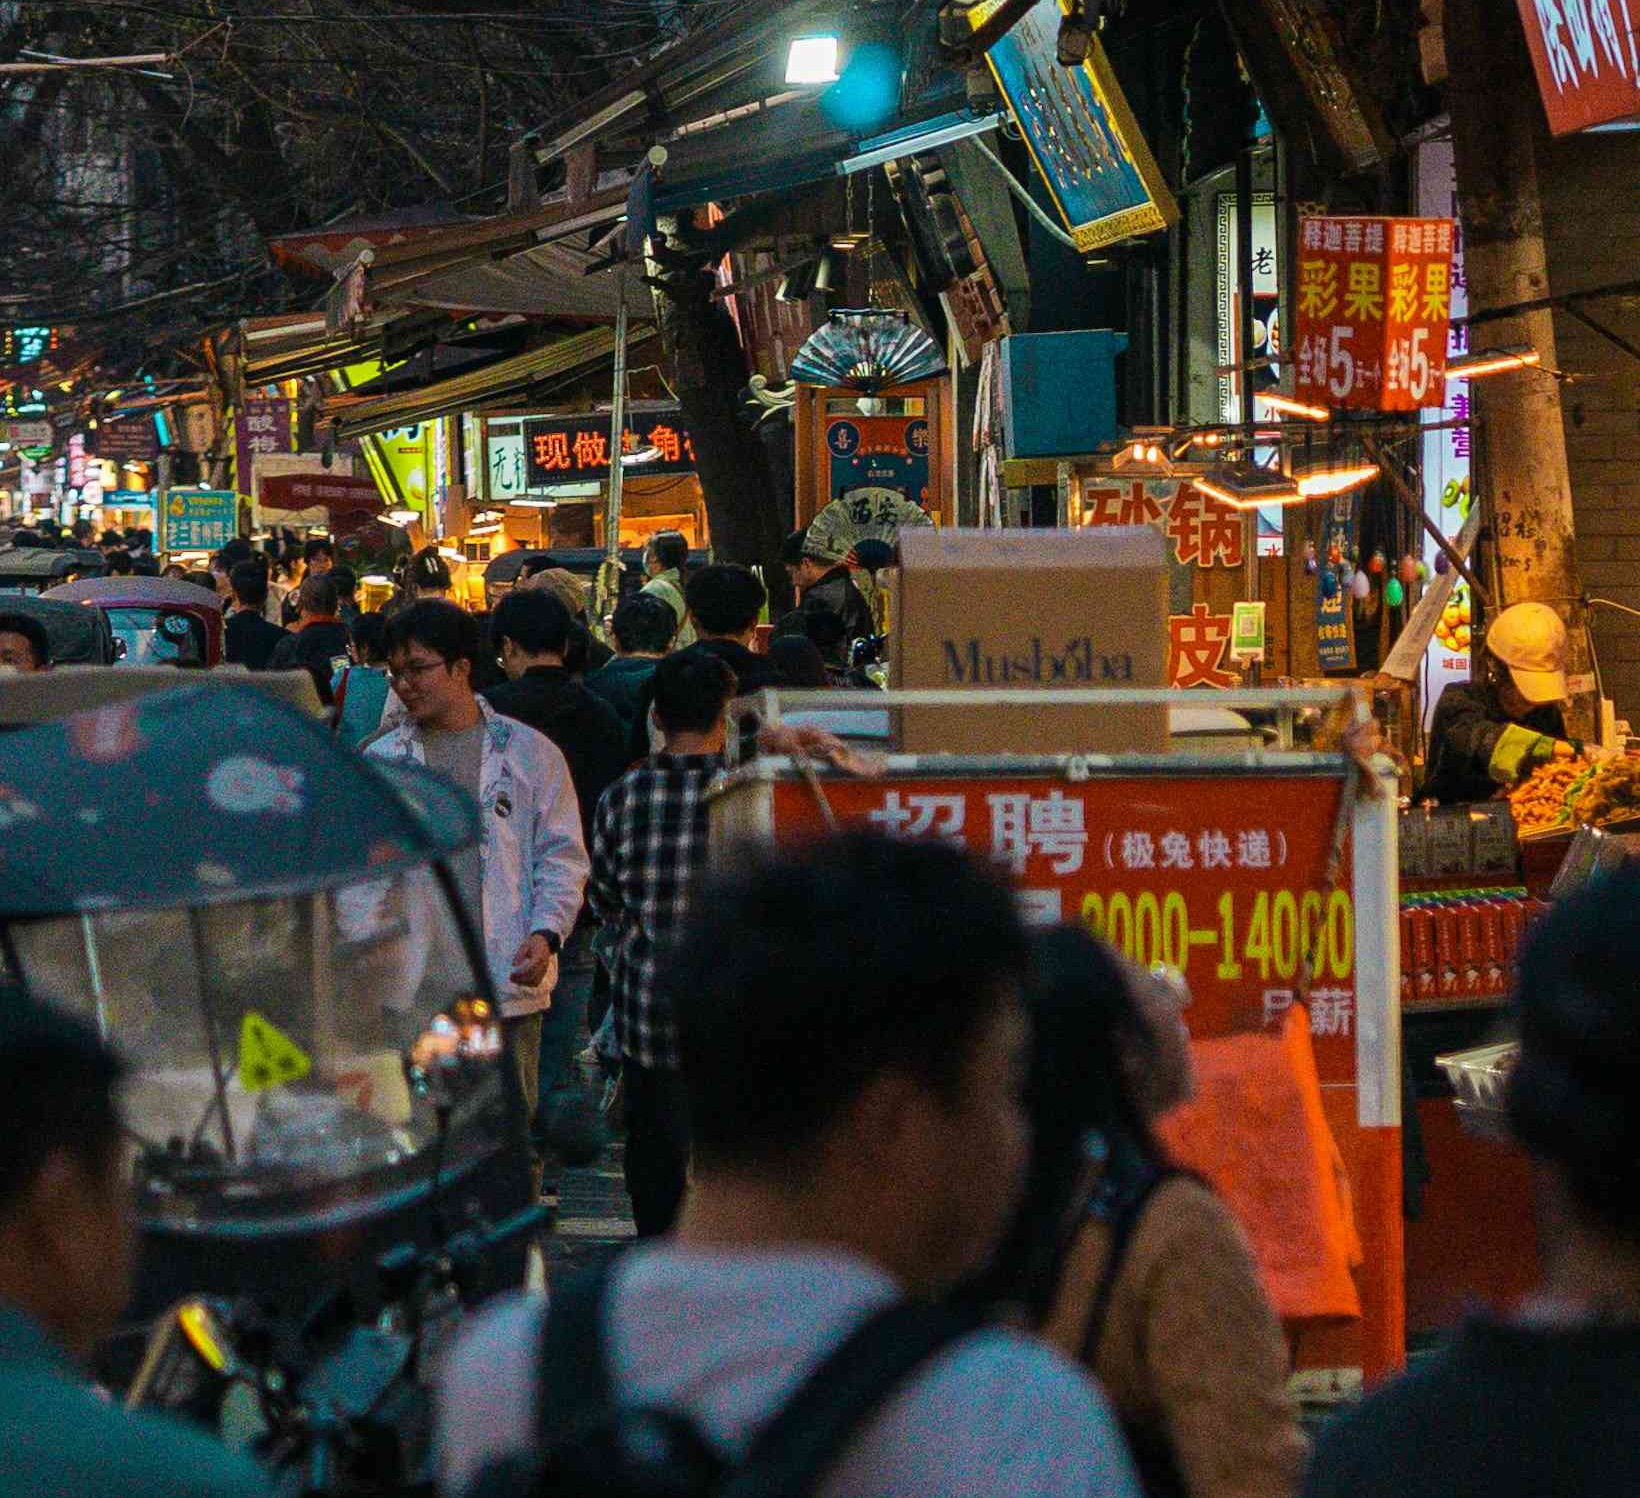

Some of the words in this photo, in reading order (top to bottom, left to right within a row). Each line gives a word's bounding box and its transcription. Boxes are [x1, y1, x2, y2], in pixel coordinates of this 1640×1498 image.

[1302, 220, 1384, 253] 释迦菩提
[1299, 261, 1385, 322] 彩果
[1388, 262, 1451, 324] 彩果
[533, 425, 697, 472] 现做角
